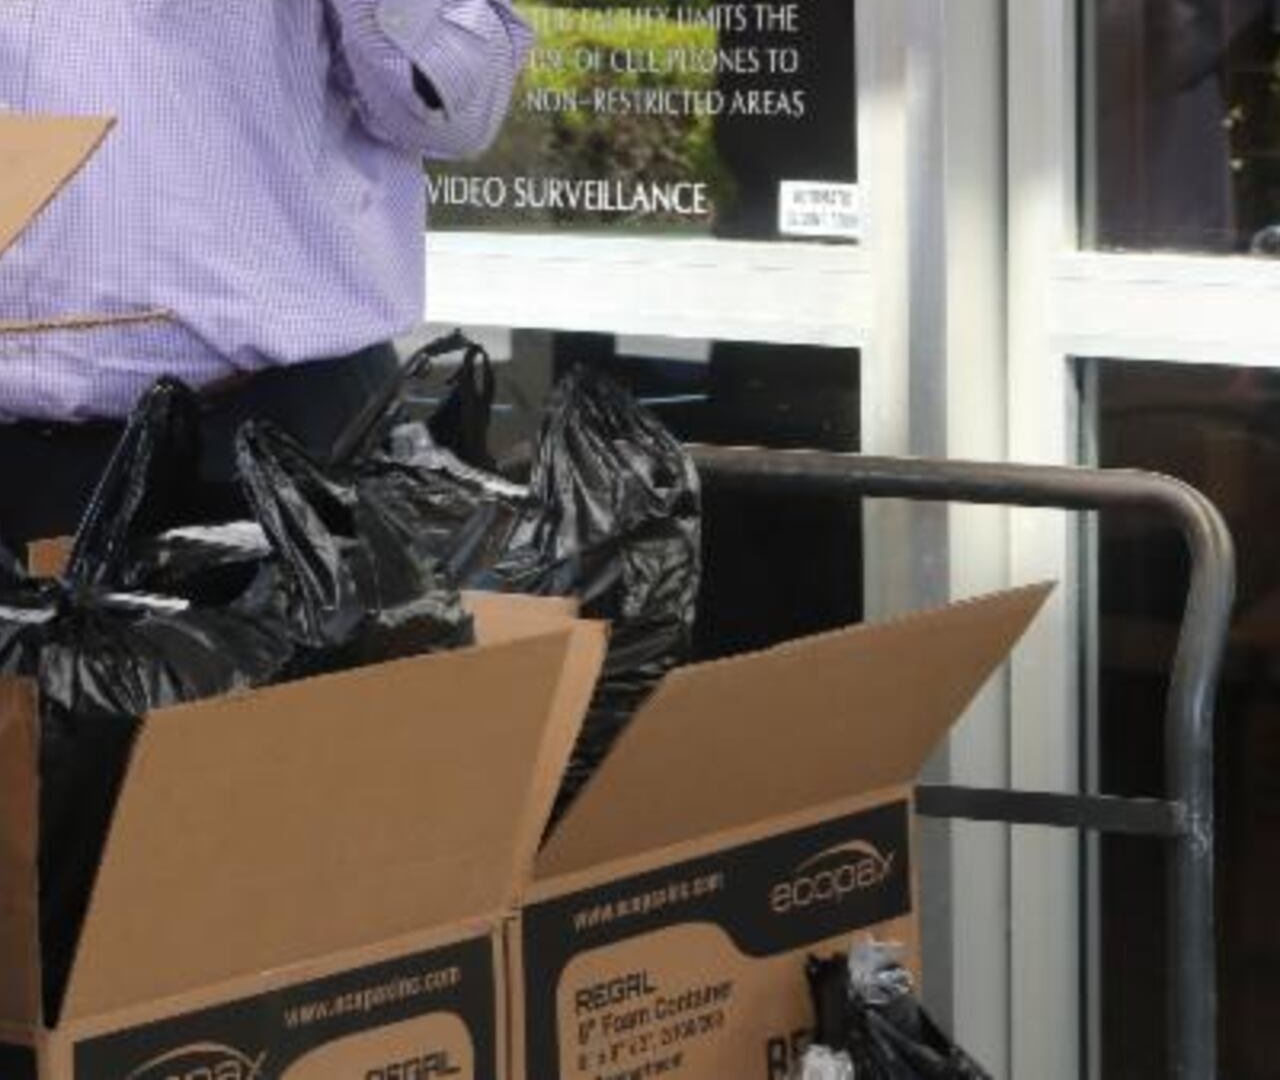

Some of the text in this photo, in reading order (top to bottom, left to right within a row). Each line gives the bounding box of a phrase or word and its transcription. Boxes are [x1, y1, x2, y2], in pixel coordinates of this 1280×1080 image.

[677, 4, 748, 32] LIMITS
[754, 3, 800, 32] THE
[575, 48, 603, 72] OF
[609, 48, 662, 73] CELL
[667, 47, 759, 73] PHONES
[767, 48, 800, 73] TO
[526, 86, 806, 117] NON-RESTRICTED AREAS
[424, 176, 709, 215] VIDEO SURVEILLANCE
[575, 969, 658, 1014] REGAL
